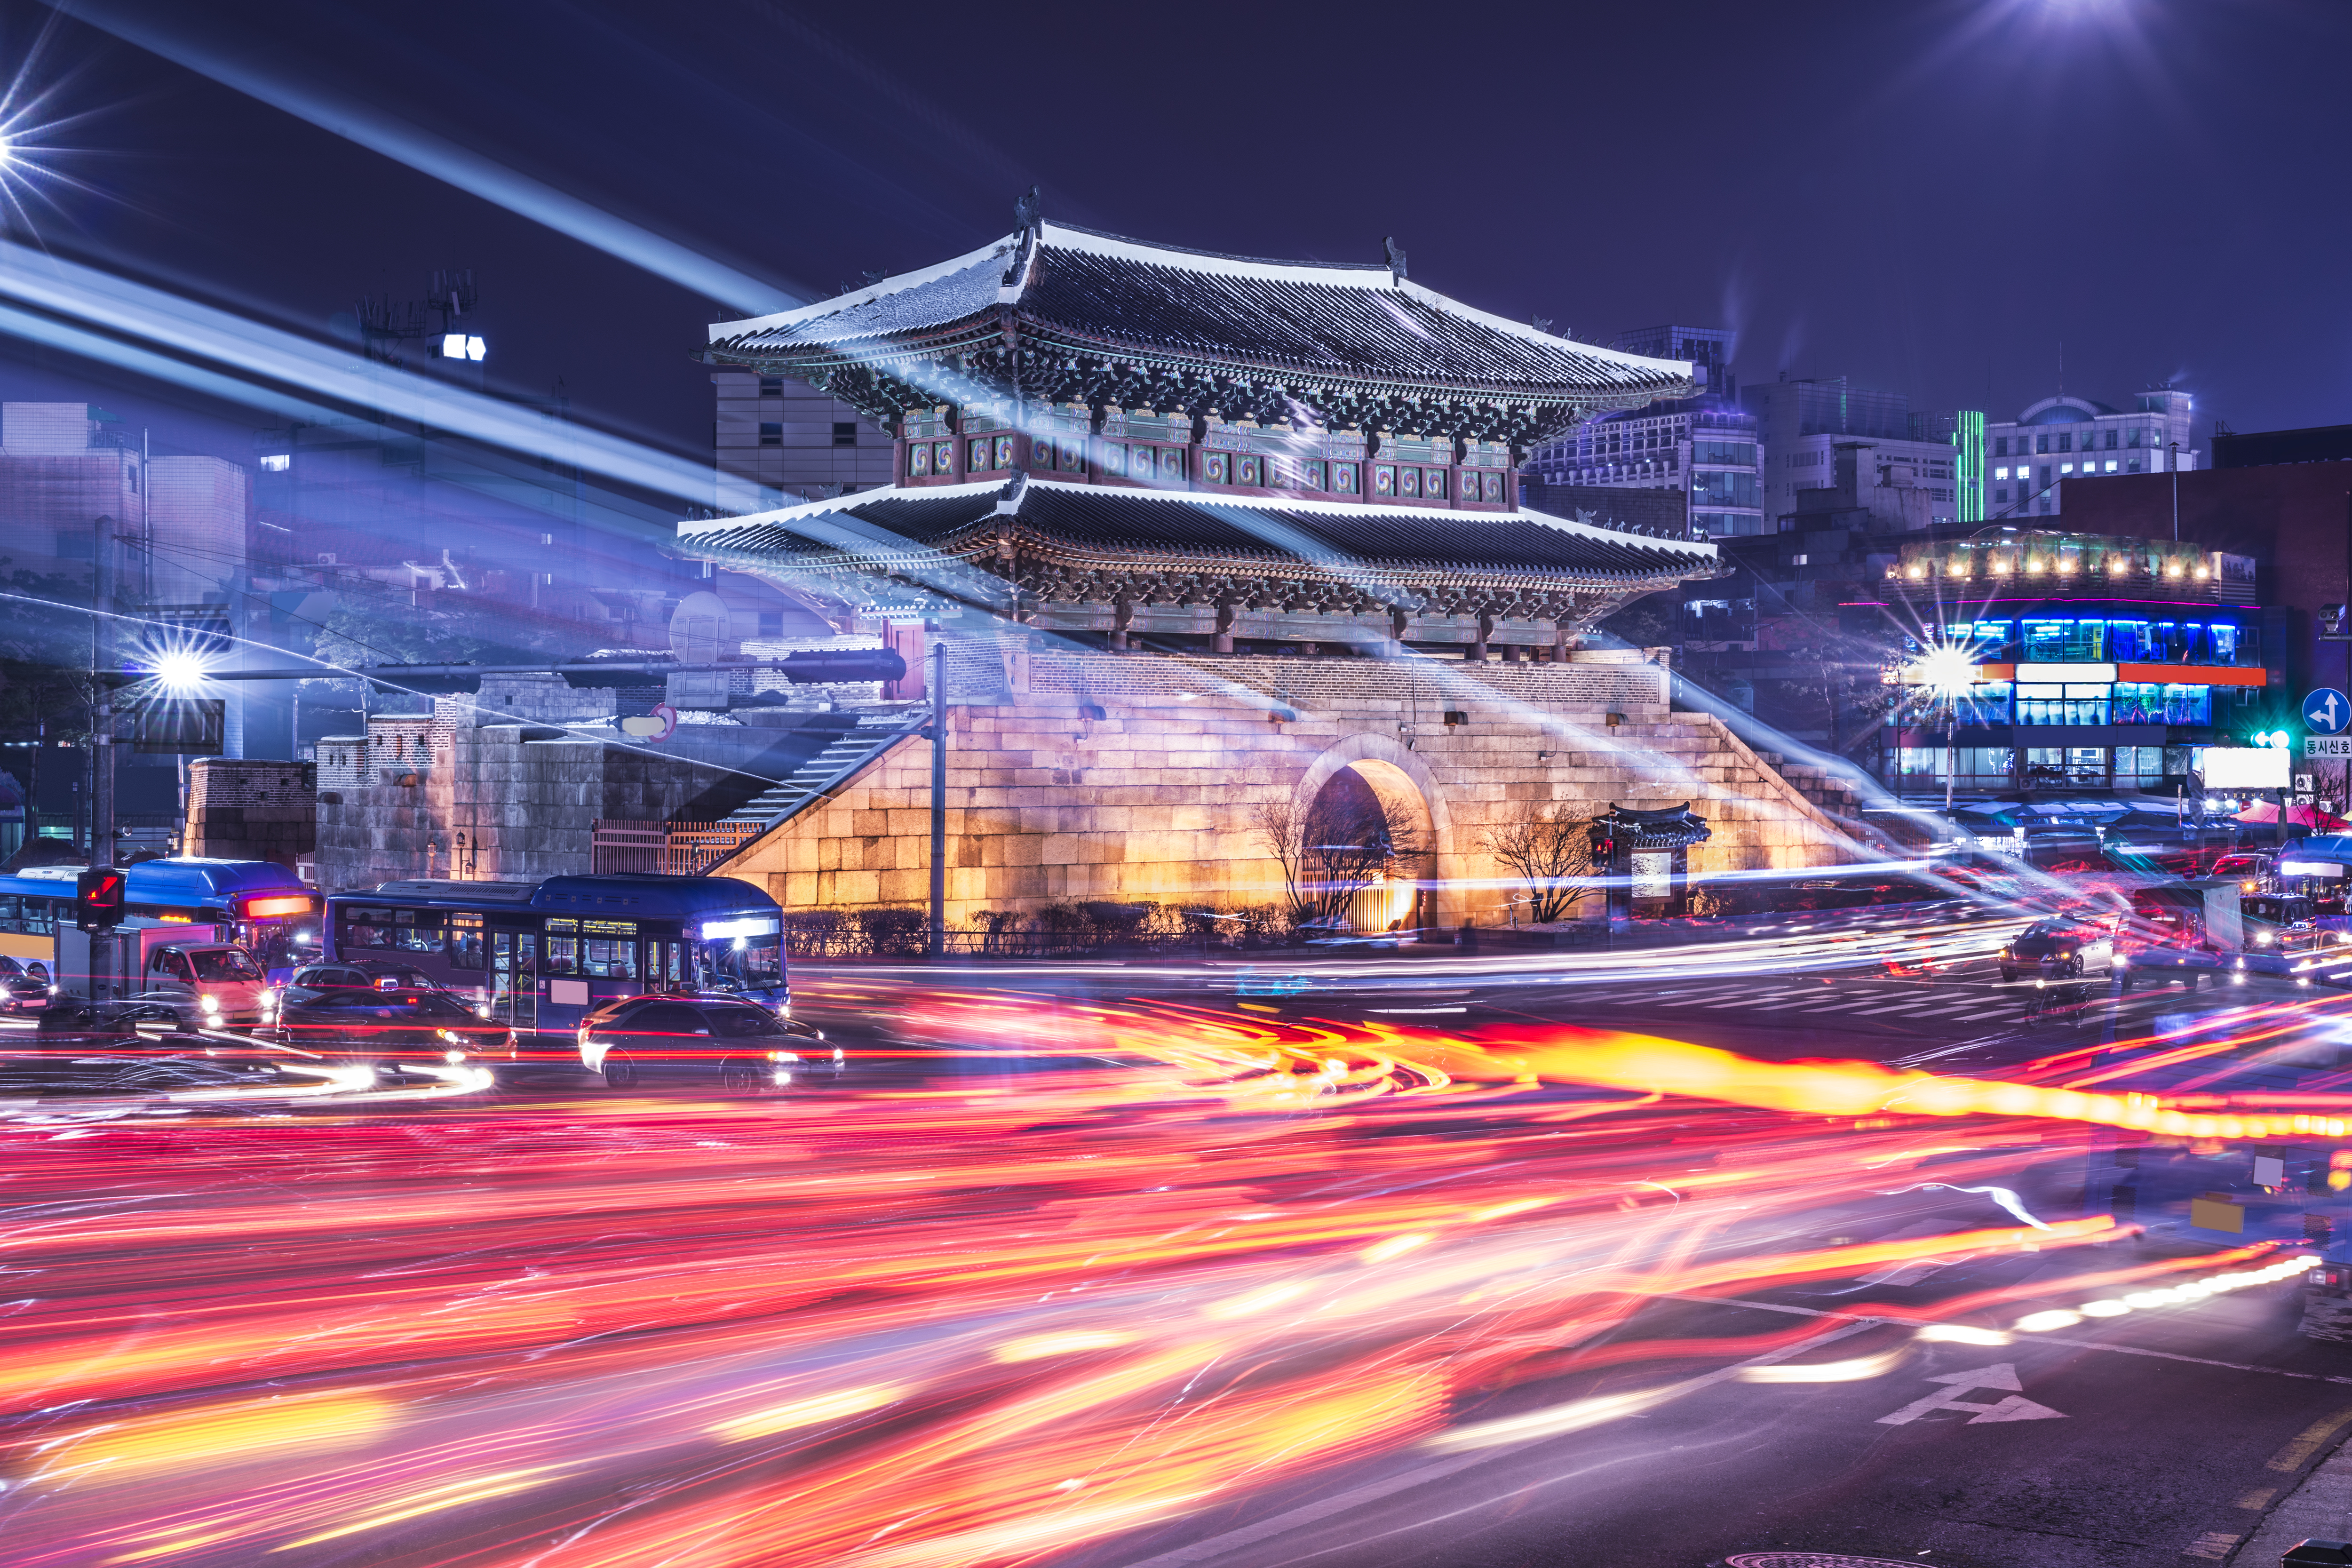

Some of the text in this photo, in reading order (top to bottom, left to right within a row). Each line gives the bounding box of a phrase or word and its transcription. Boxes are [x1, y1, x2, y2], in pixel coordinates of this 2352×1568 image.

[147, 631, 161, 641] 283
[176, 623, 198, 637] 종로
[213, 630, 228, 640] 279
[2307, 740, 2350, 754] 동시신호
